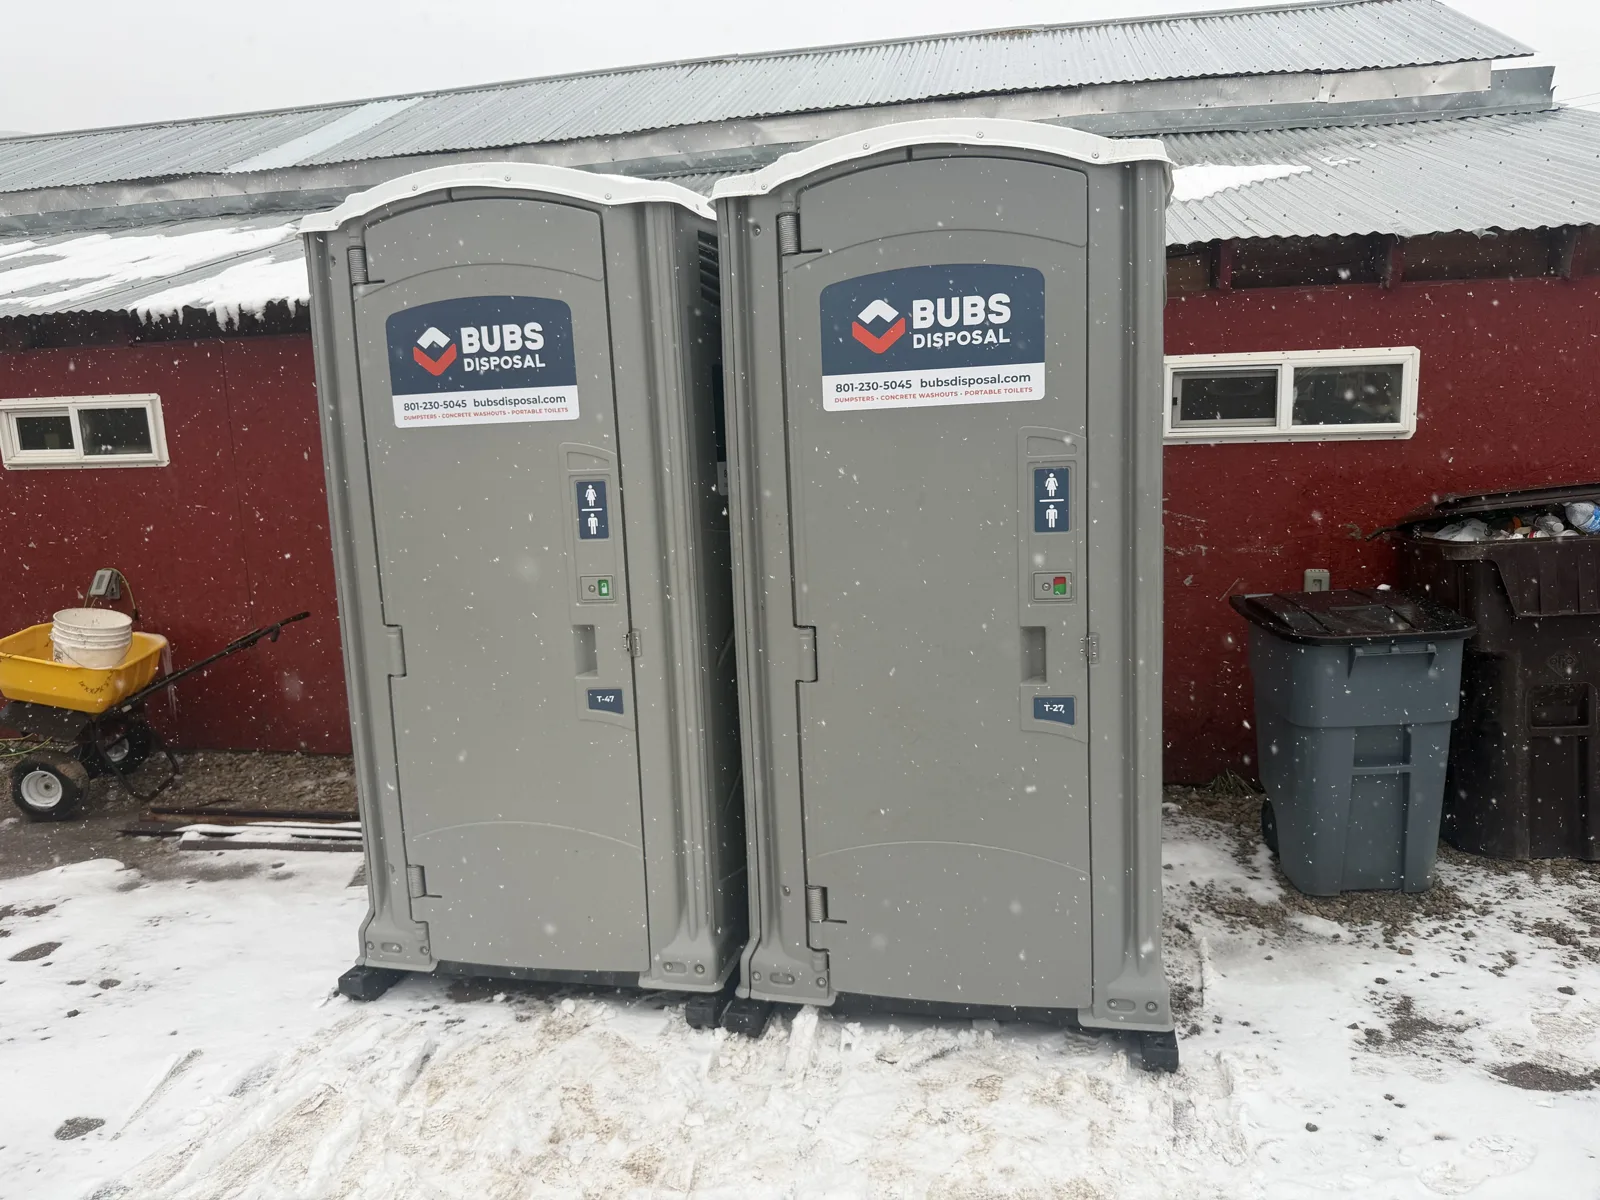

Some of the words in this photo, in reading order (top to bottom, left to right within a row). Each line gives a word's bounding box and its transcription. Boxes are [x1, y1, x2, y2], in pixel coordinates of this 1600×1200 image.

[912, 293, 1011, 329] BUBS
[460, 322, 544, 354] BUBS
[913, 328, 1010, 349] DISPOSAL
[464, 354, 546, 372] DISPOSAL
[836, 380, 912, 392] 801-230-5045
[920, 374, 1031, 388] bubsdisposal.com
[404, 400, 467, 412] 801-230-5045
[473, 394, 566, 408] bubsdisposal.com
[834, 395, 875, 403] DUMPSTERS
[880, 393, 917, 401] CONCRETE
[918, 391, 958, 399] WASHOUTS
